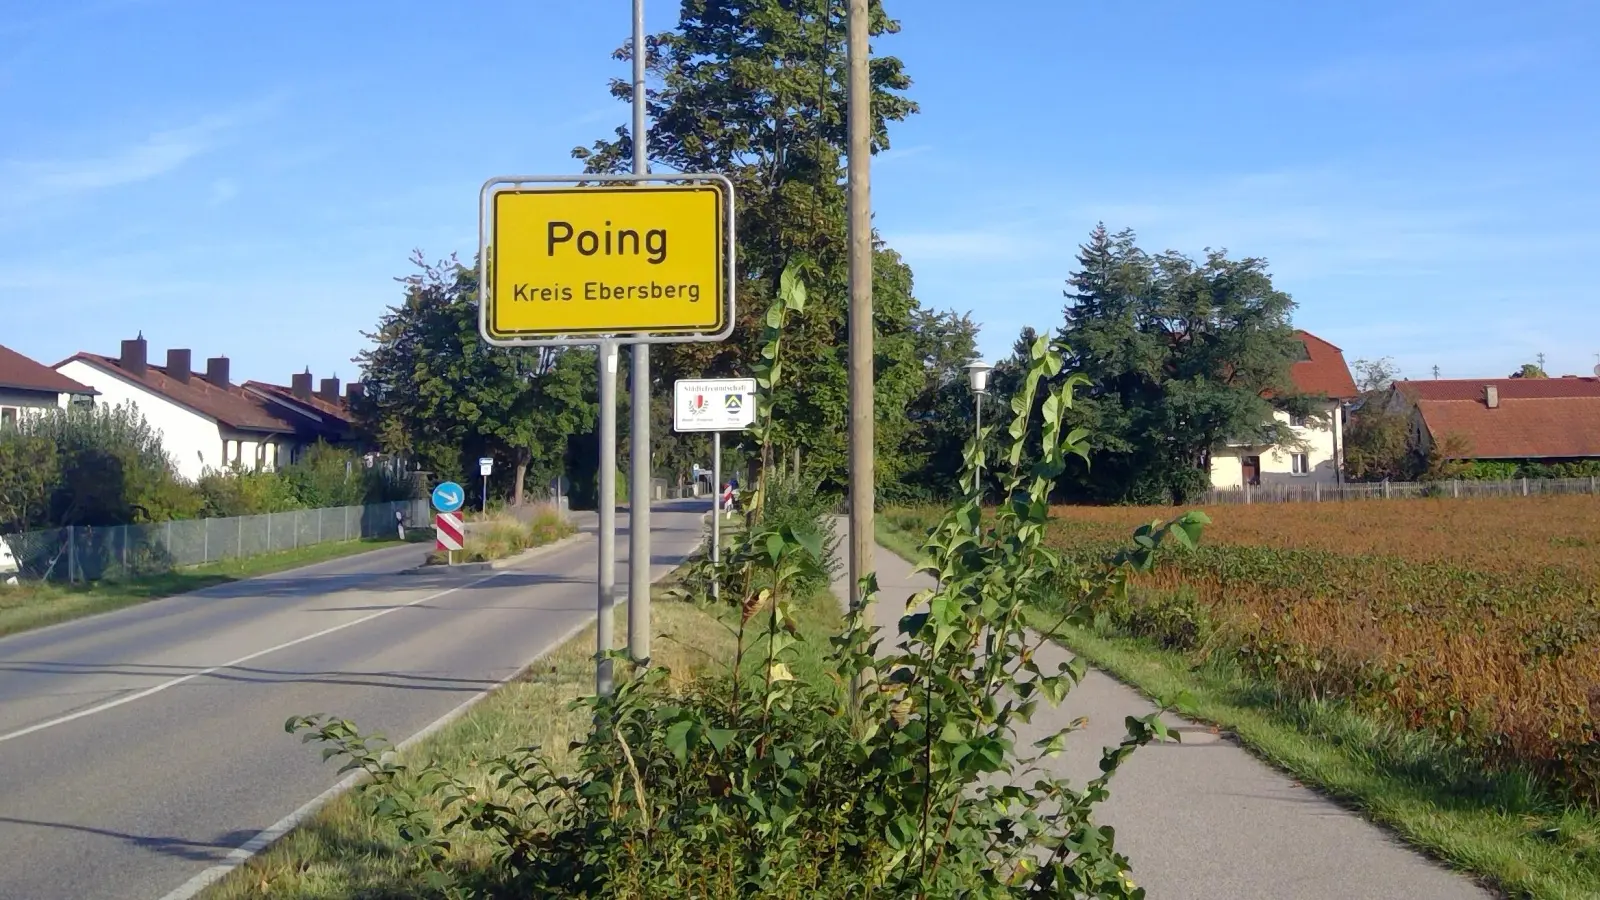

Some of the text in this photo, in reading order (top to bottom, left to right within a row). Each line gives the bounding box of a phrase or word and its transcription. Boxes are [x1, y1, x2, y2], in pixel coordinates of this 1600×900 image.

[548, 221, 666, 264] Poing
[514, 281, 700, 303] Kreis Ebersberg
